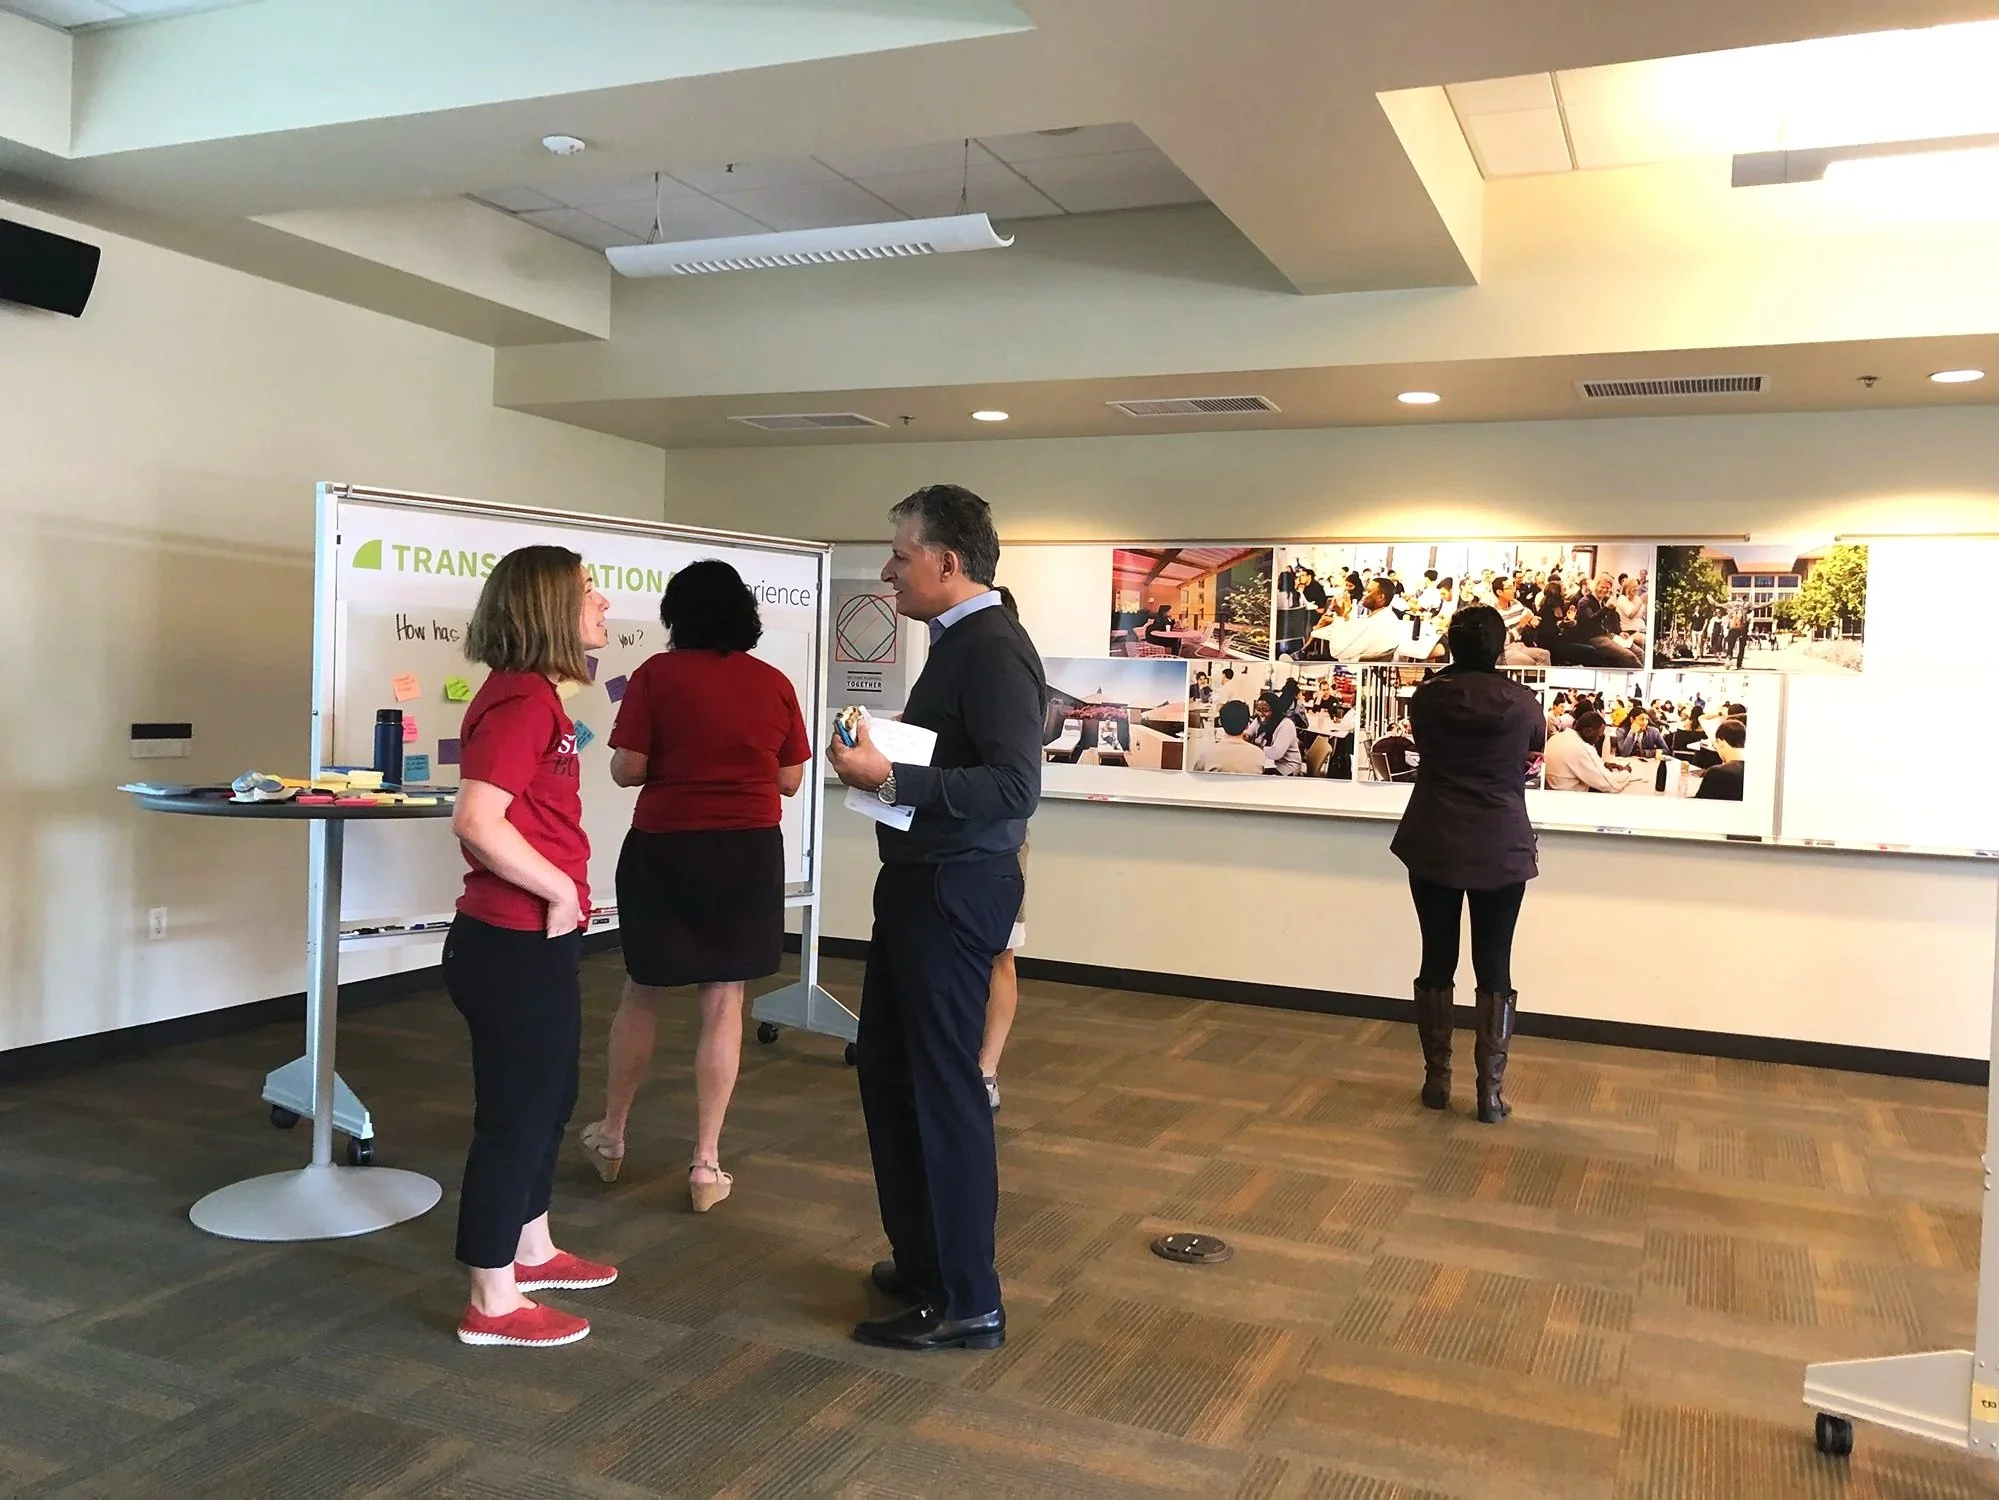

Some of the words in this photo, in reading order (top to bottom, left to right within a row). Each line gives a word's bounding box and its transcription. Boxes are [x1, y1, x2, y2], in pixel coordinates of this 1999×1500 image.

[396, 613, 426, 641] How
[432, 619, 461, 642] has
[846, 680, 882, 689] TOGETHER
